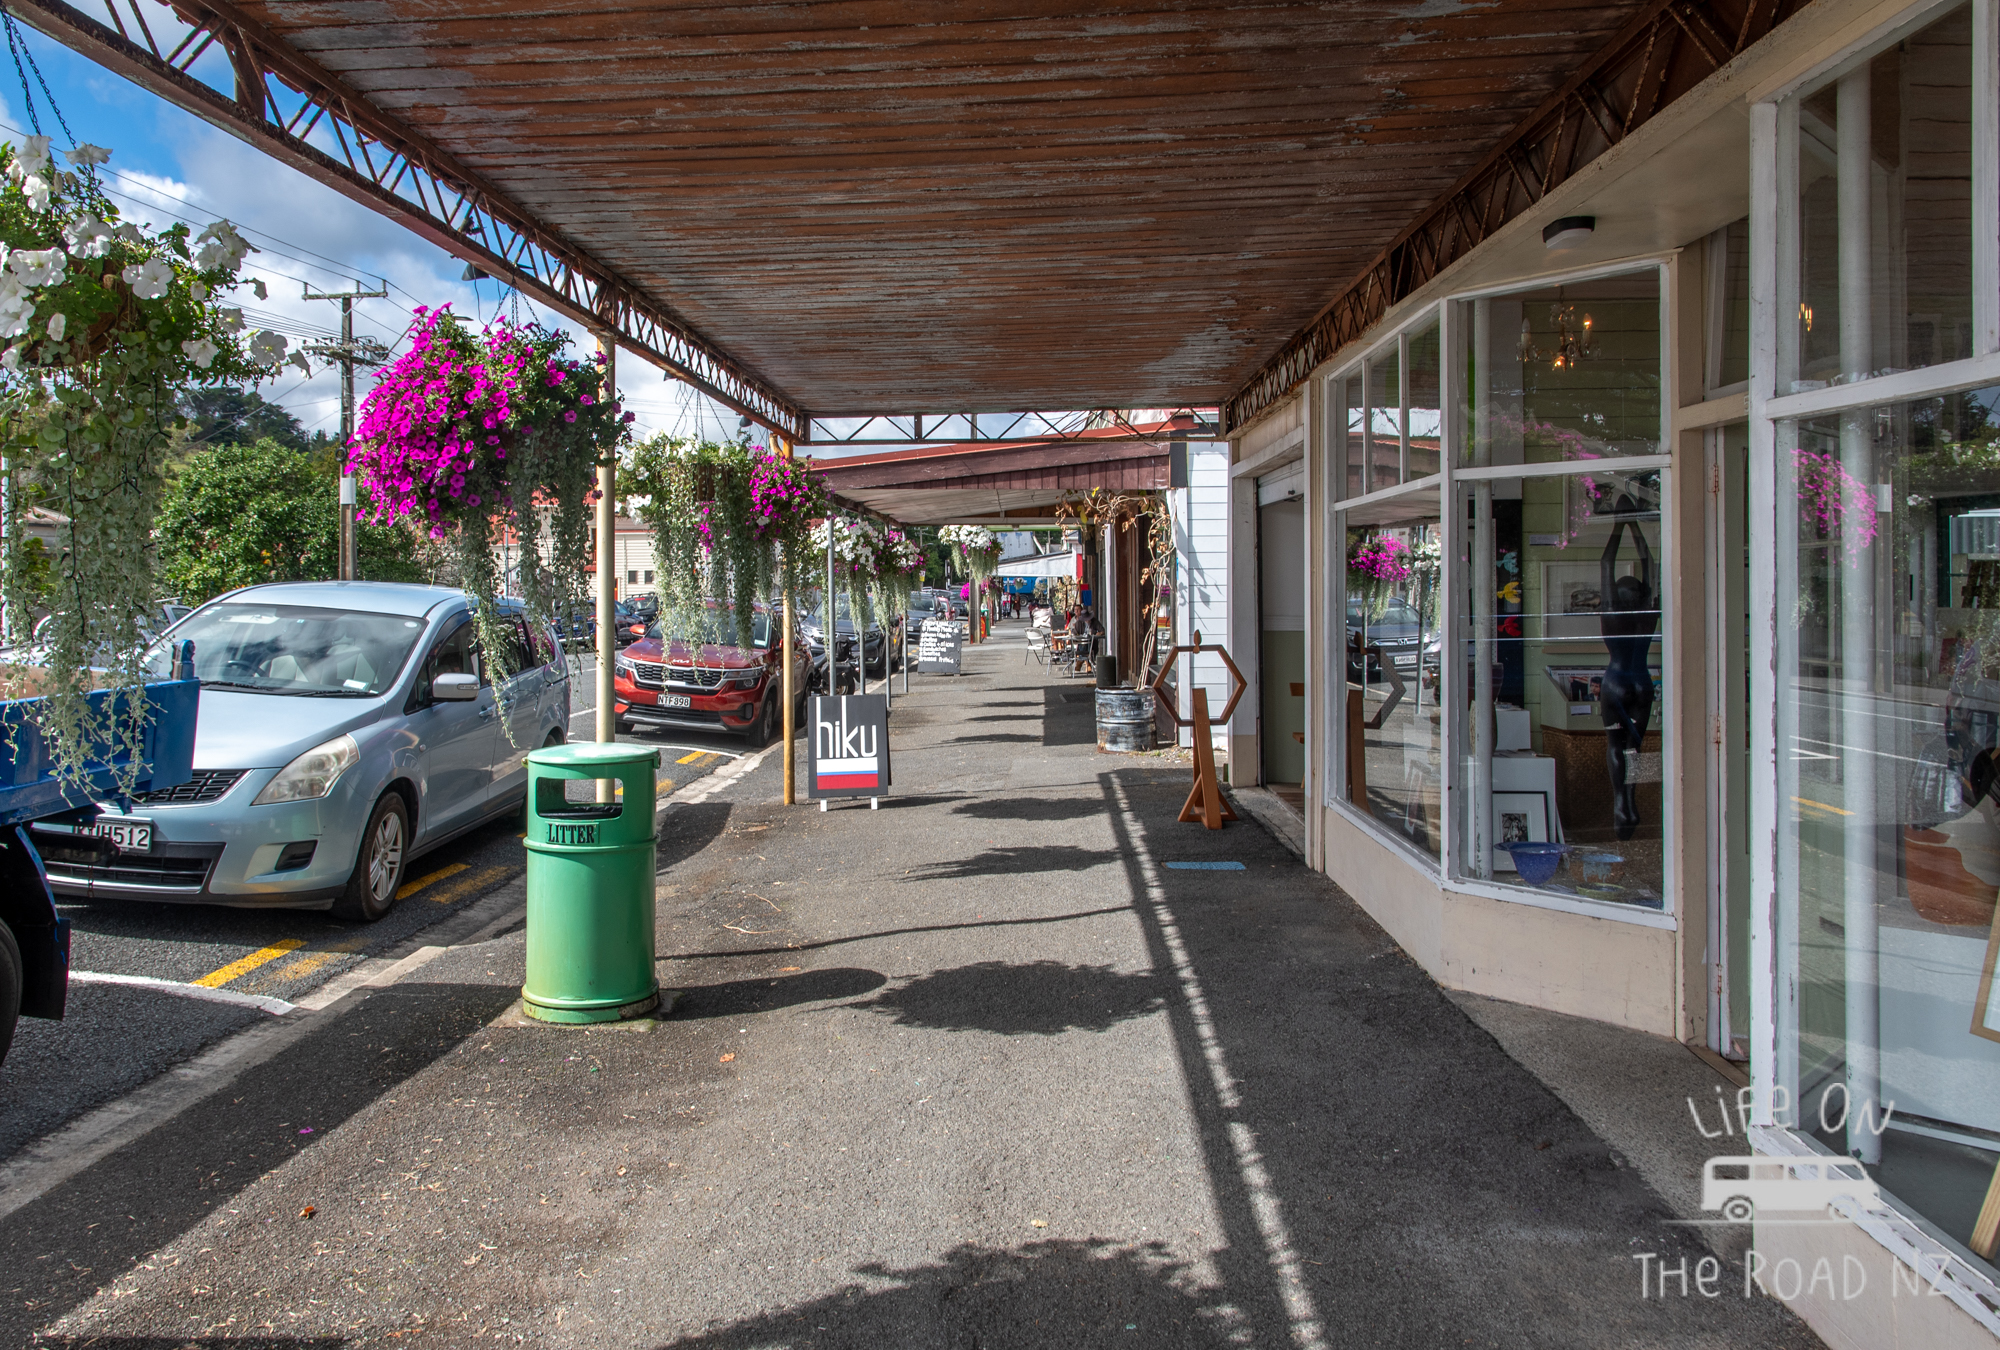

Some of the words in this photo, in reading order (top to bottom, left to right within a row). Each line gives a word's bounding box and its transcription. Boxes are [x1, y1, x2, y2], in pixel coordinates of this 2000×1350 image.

[659, 695, 690, 706] NTF898
[815, 695, 877, 758] hiku
[548, 823, 595, 844] LITTER
